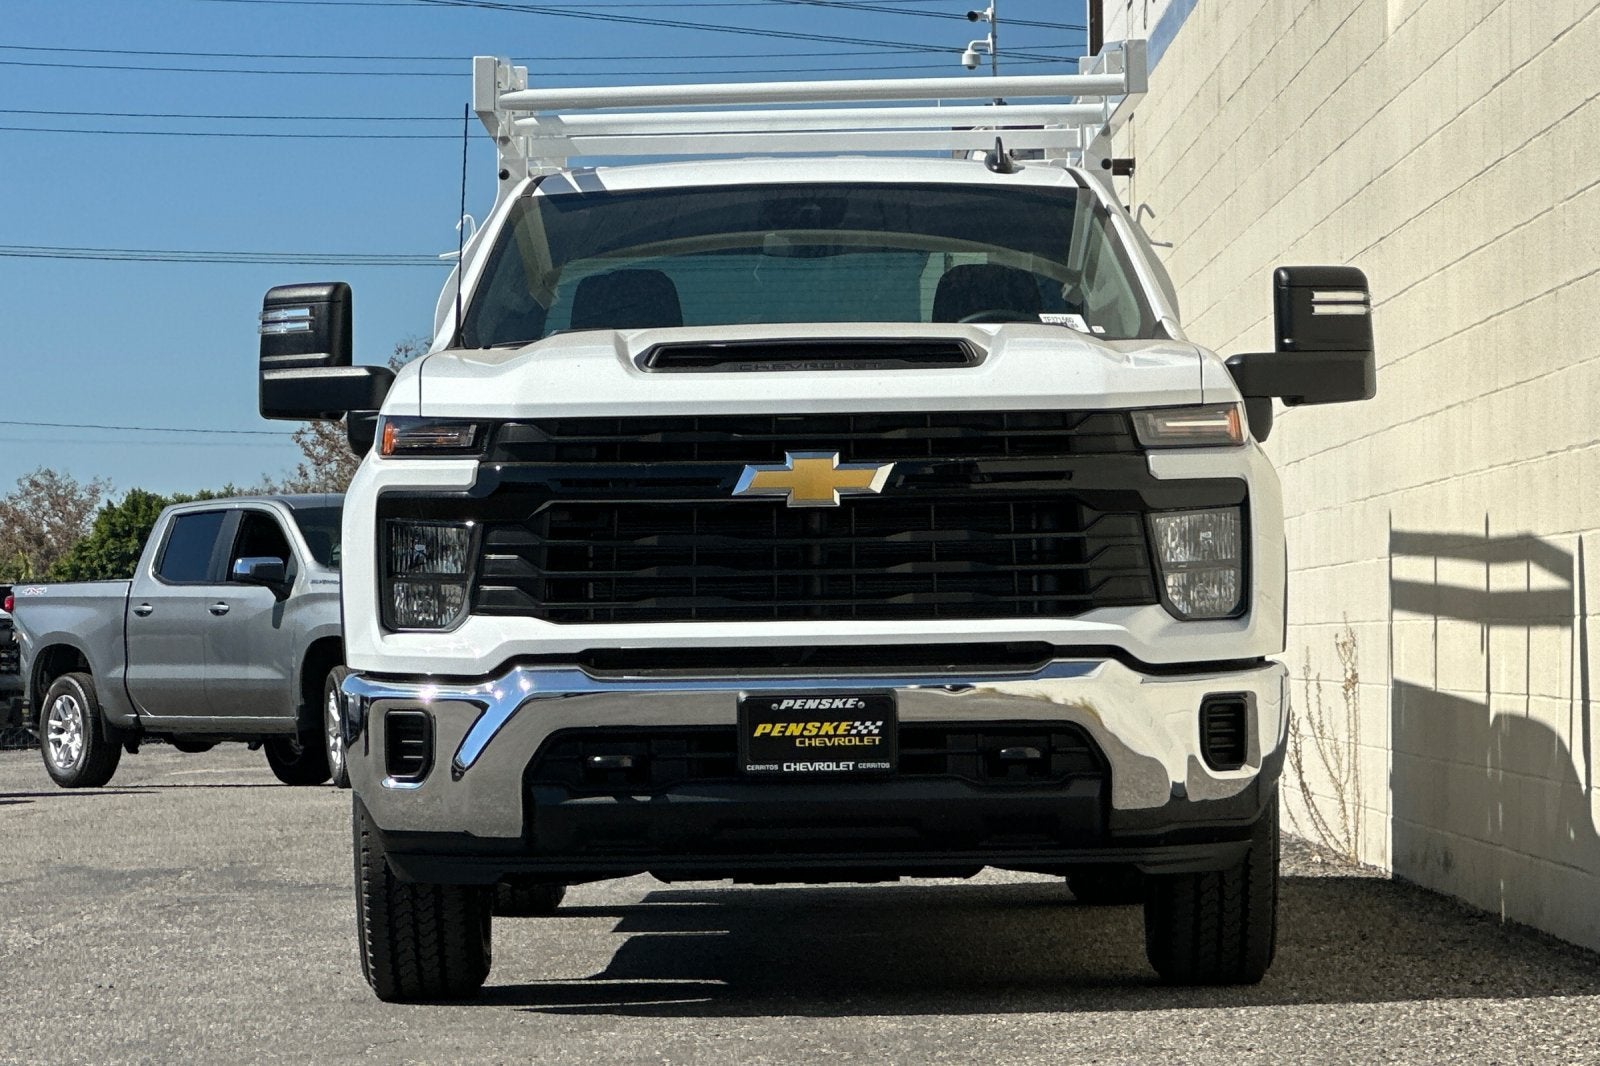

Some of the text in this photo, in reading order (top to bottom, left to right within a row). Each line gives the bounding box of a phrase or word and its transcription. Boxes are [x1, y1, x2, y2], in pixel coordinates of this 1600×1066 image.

[779, 698, 859, 710] PENSKE
[753, 721, 853, 737] PENSKE
[795, 736, 882, 747] CHEVROLET
[783, 761, 855, 772] CHEVROLET
